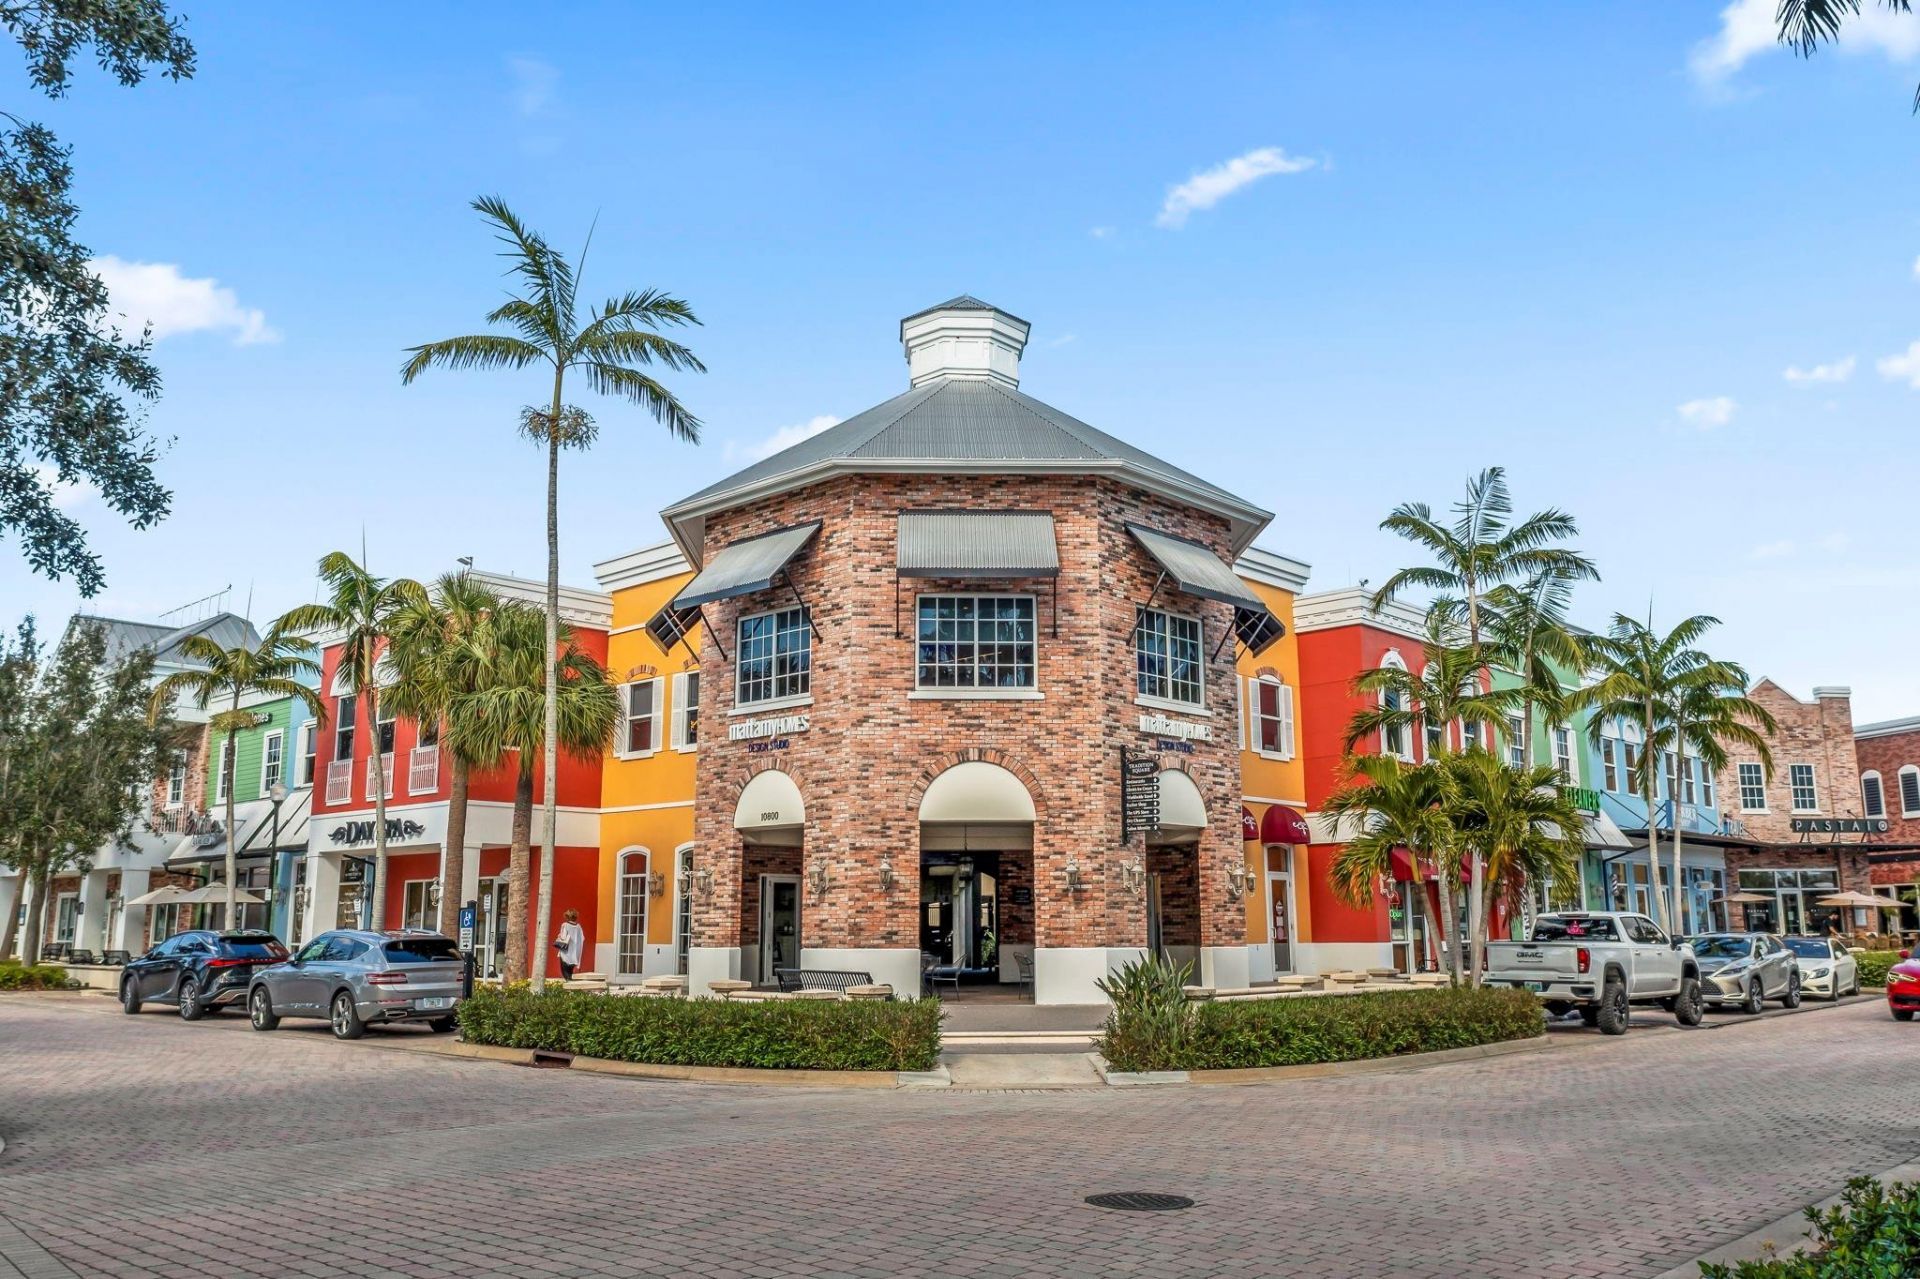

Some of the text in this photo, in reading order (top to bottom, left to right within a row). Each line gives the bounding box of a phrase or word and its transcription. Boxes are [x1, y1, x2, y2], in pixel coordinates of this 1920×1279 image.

[749, 739, 790, 753] DESIGN STUDIO
[1157, 740, 1175, 752] DESIGN
[1132, 767, 1151, 775] SQUARE
[761, 811, 779, 821] 10800
[1795, 821, 1888, 831] PASTAIO
[346, 821, 376, 843] DAY
